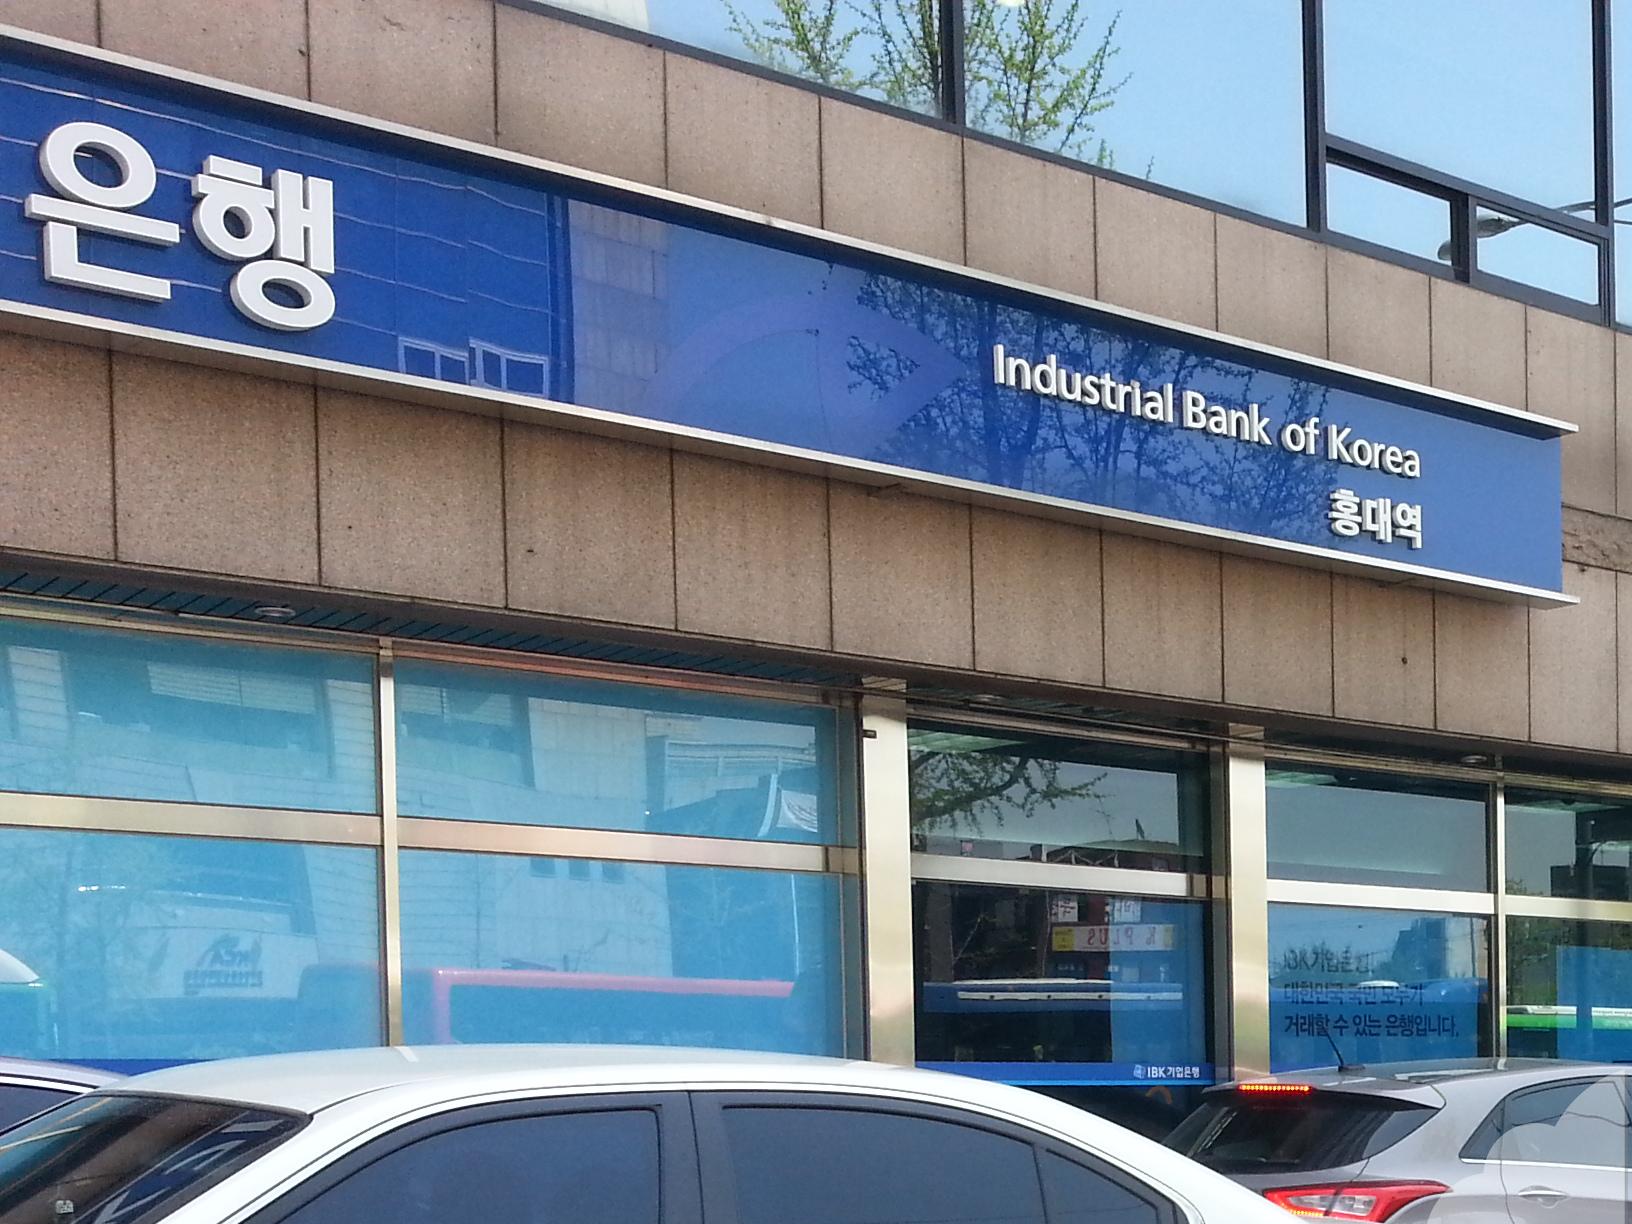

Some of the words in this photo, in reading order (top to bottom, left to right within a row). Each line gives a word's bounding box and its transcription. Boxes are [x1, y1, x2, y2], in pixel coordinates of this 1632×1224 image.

[24, 121, 336, 332] 은행
[993, 343, 1174, 424] Industrial
[1182, 389, 1273, 447] Bank
[1281, 416, 1320, 455] of
[1327, 423, 1421, 479] Korea
[1327, 487, 1422, 549] 홍대역
[1284, 1013, 1330, 1037] 거래할
[1333, 1015, 1349, 1036] 수
[1352, 1014, 1382, 1037] 있는
[1147, 1065, 1200, 1079] IBK기업은행
